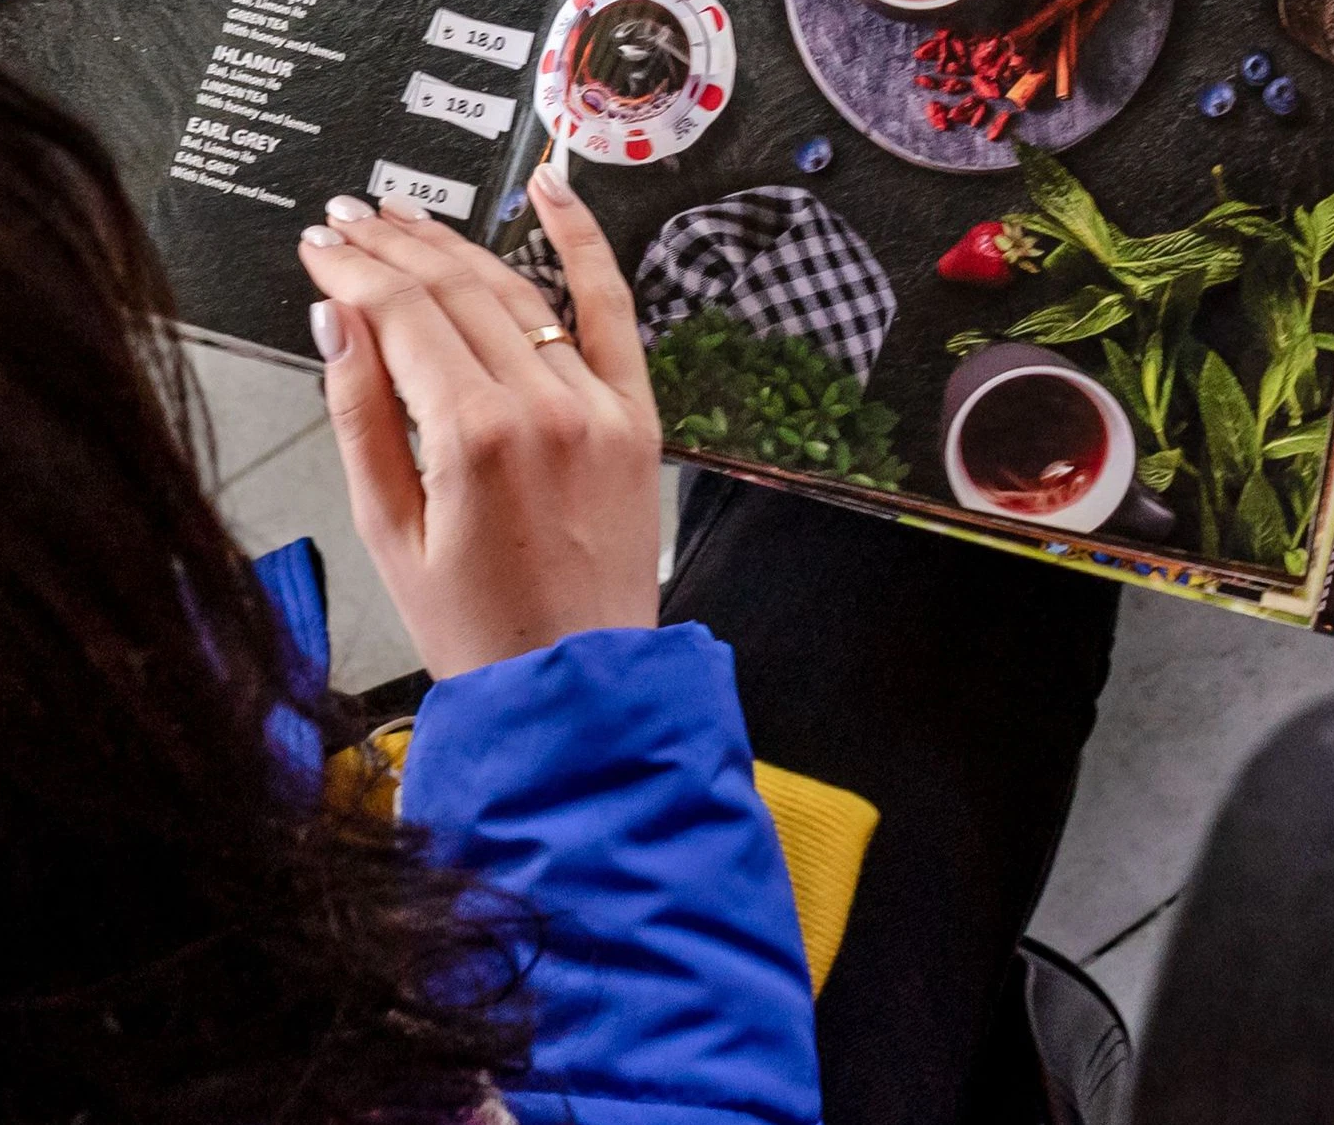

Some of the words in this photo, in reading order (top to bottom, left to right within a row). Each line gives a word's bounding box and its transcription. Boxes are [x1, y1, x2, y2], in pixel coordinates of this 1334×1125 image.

[466, 30, 505, 51] 18,0
[212, 45, 294, 78] IHLAMUR
[445, 97, 485, 118] 18,0
[186, 117, 230, 141] EARL
[232, 129, 282, 153] GREY
[174, 151, 206, 168] EARL
[204, 159, 239, 176] GREY
[408, 182, 448, 204] 18,0
